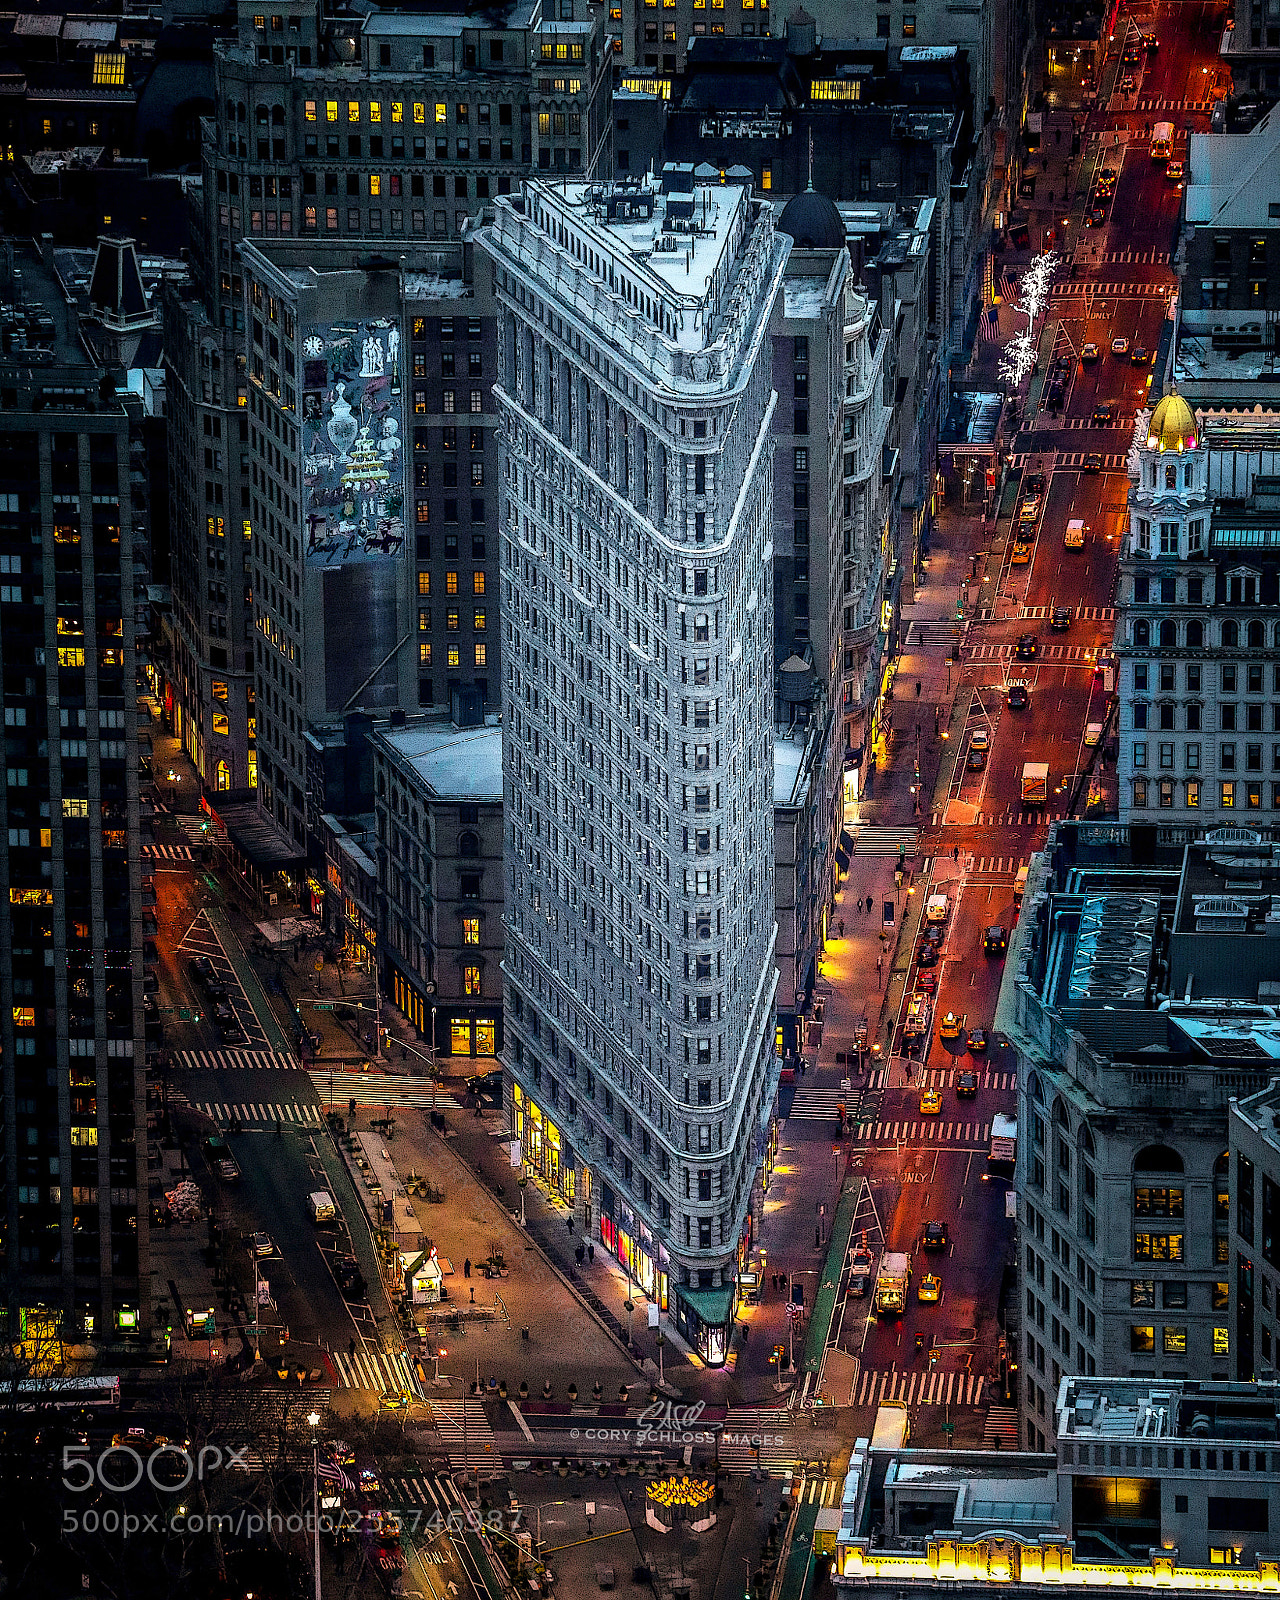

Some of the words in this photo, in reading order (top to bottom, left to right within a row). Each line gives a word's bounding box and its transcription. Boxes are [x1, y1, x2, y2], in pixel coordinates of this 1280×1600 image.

[1090, 312, 1113, 320] ONLY
[1007, 678, 1032, 687] ONLY
[900, 1172, 929, 1183] ONLY
[424, 1550, 455, 1565] ONLY
